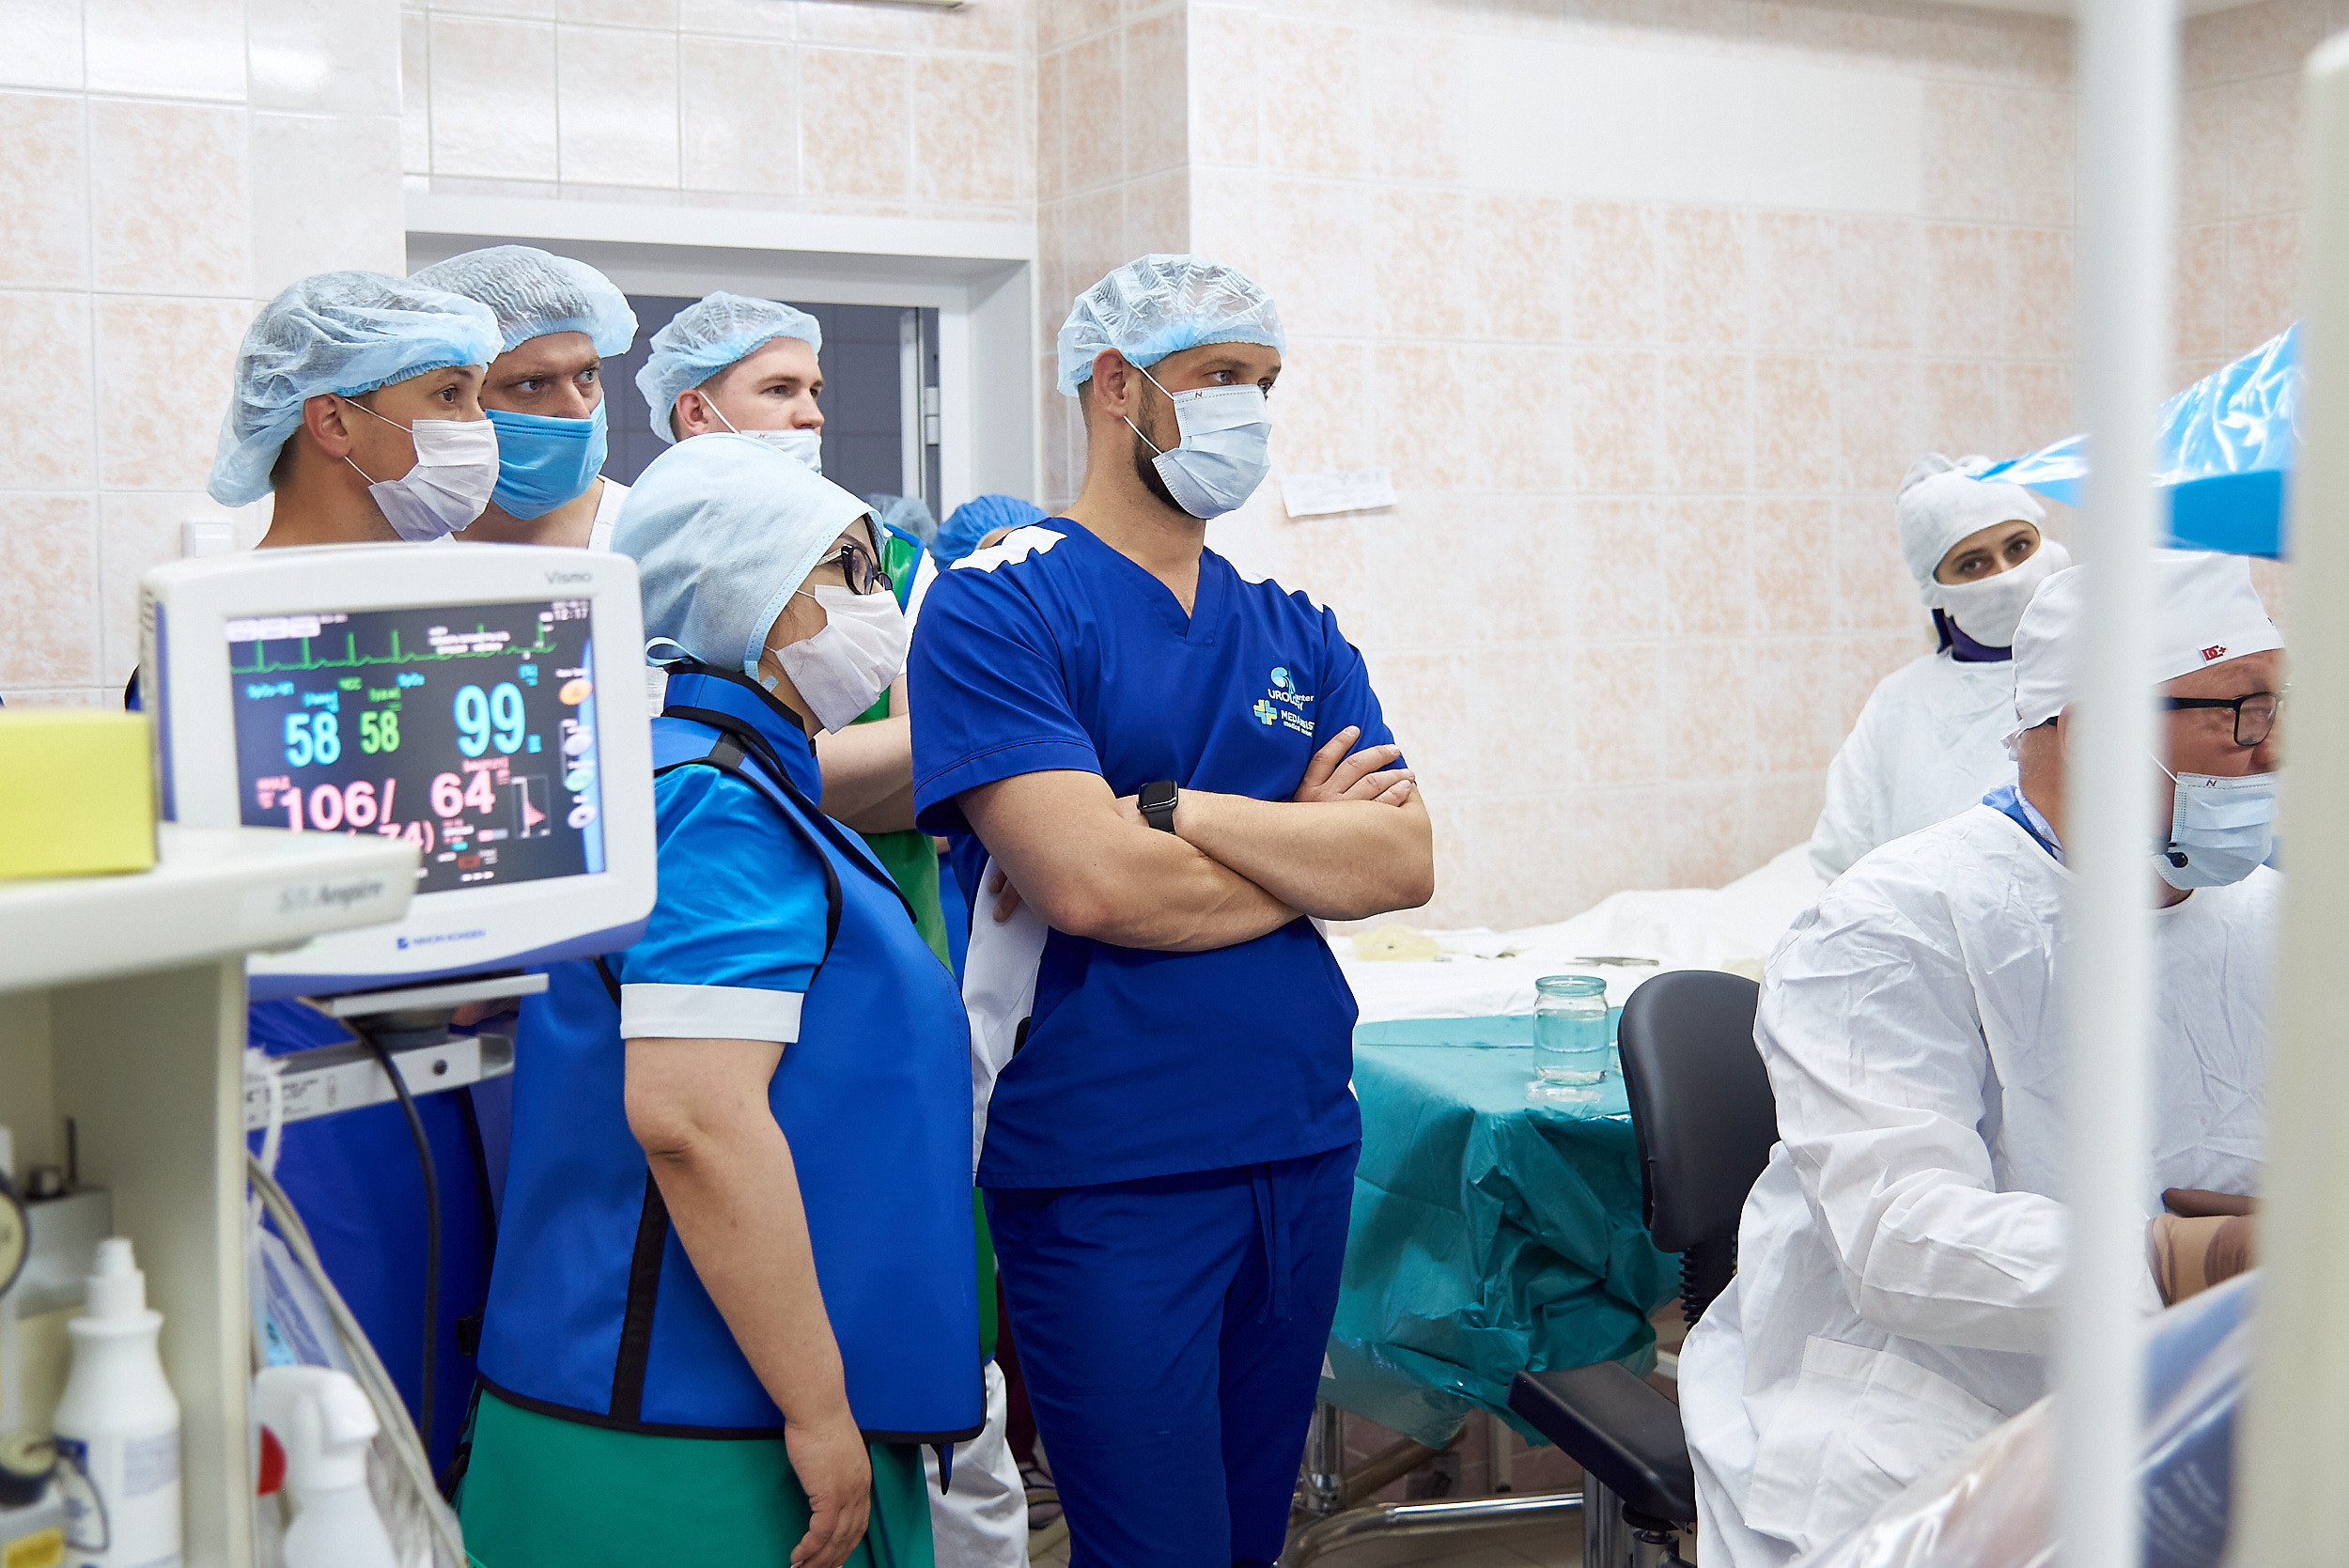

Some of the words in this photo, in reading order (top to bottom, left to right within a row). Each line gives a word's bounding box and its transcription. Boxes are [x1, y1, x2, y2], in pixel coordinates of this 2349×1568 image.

[284, 711, 341, 767] 58
[359, 710, 400, 754] 58
[454, 682, 526, 757] 99
[430, 771, 497, 818] 64
